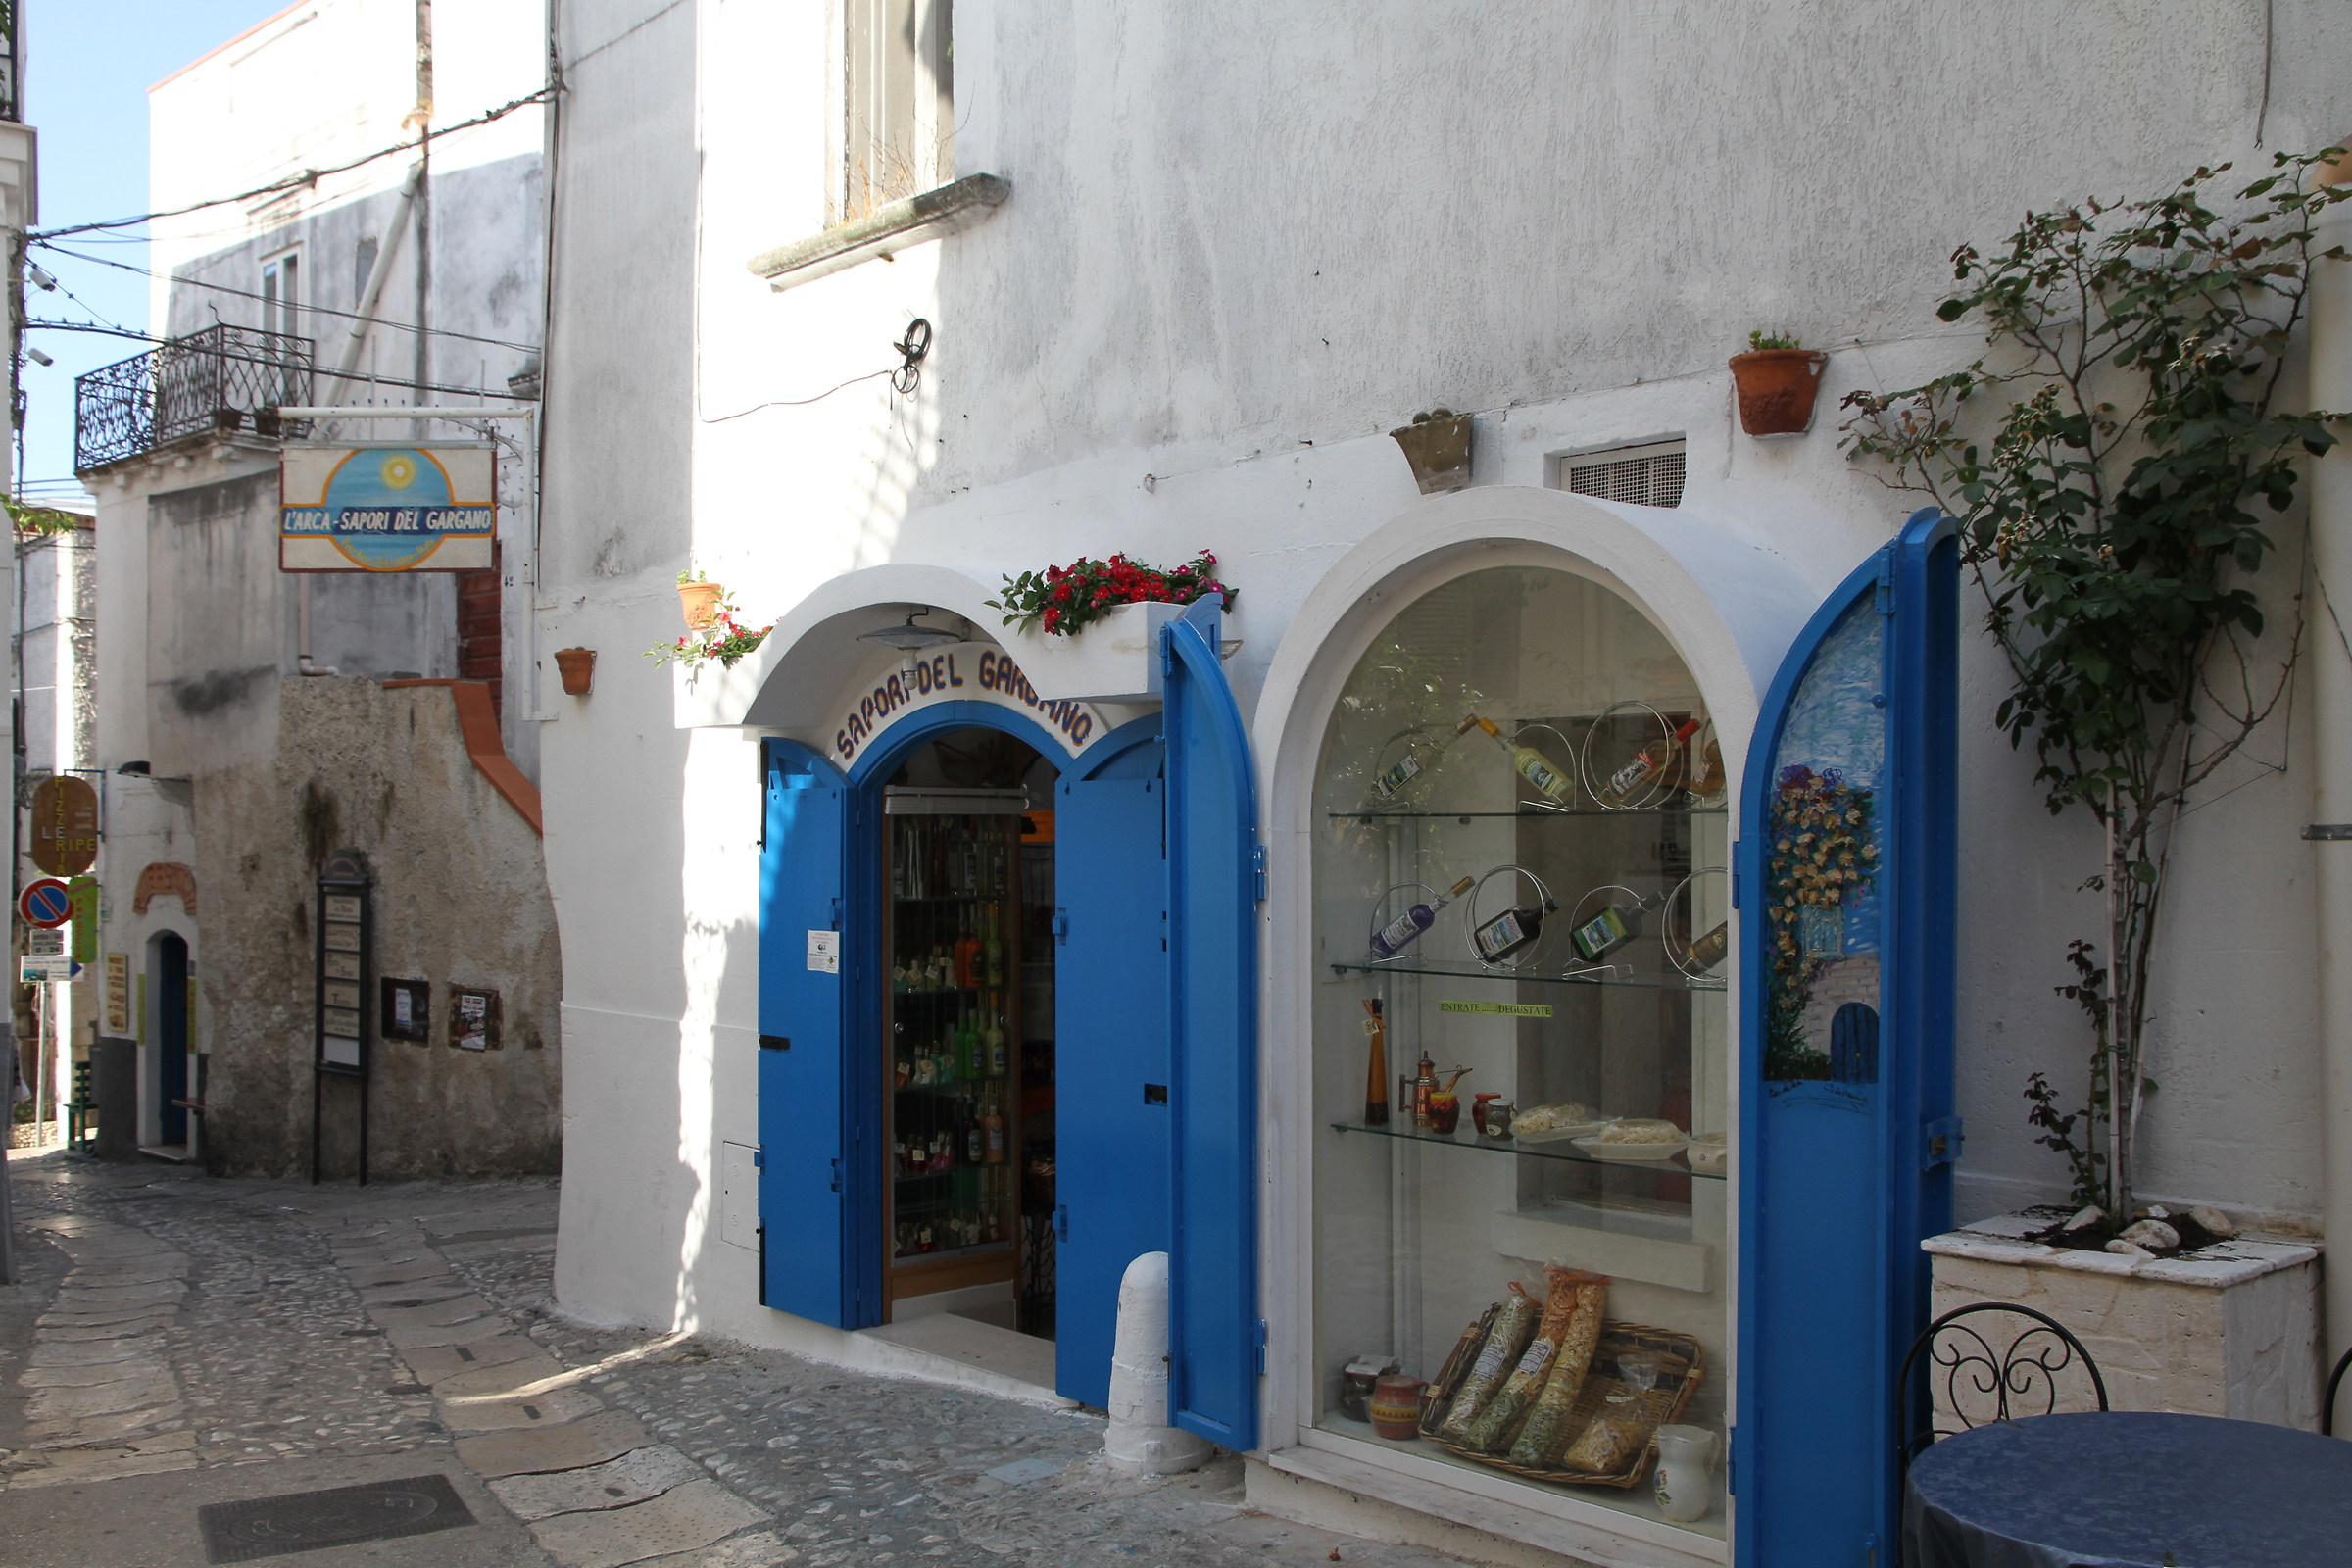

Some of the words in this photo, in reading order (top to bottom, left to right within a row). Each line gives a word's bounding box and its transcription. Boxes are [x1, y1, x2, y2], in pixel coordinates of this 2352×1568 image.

[282, 511, 331, 531] L'ARCA
[340, 511, 391, 531] SAPORI
[393, 511, 420, 531] DEL
[425, 510, 492, 530] GARGANO
[836, 668, 911, 760] SAPORI
[917, 653, 964, 696] DEL
[55, 776, 66, 876] PIZZERIA
[55, 838, 96, 852] RIPE
[1440, 1002, 1481, 1012] ENTRATE
[1497, 1004, 1552, 1016] DEGUSTATE
